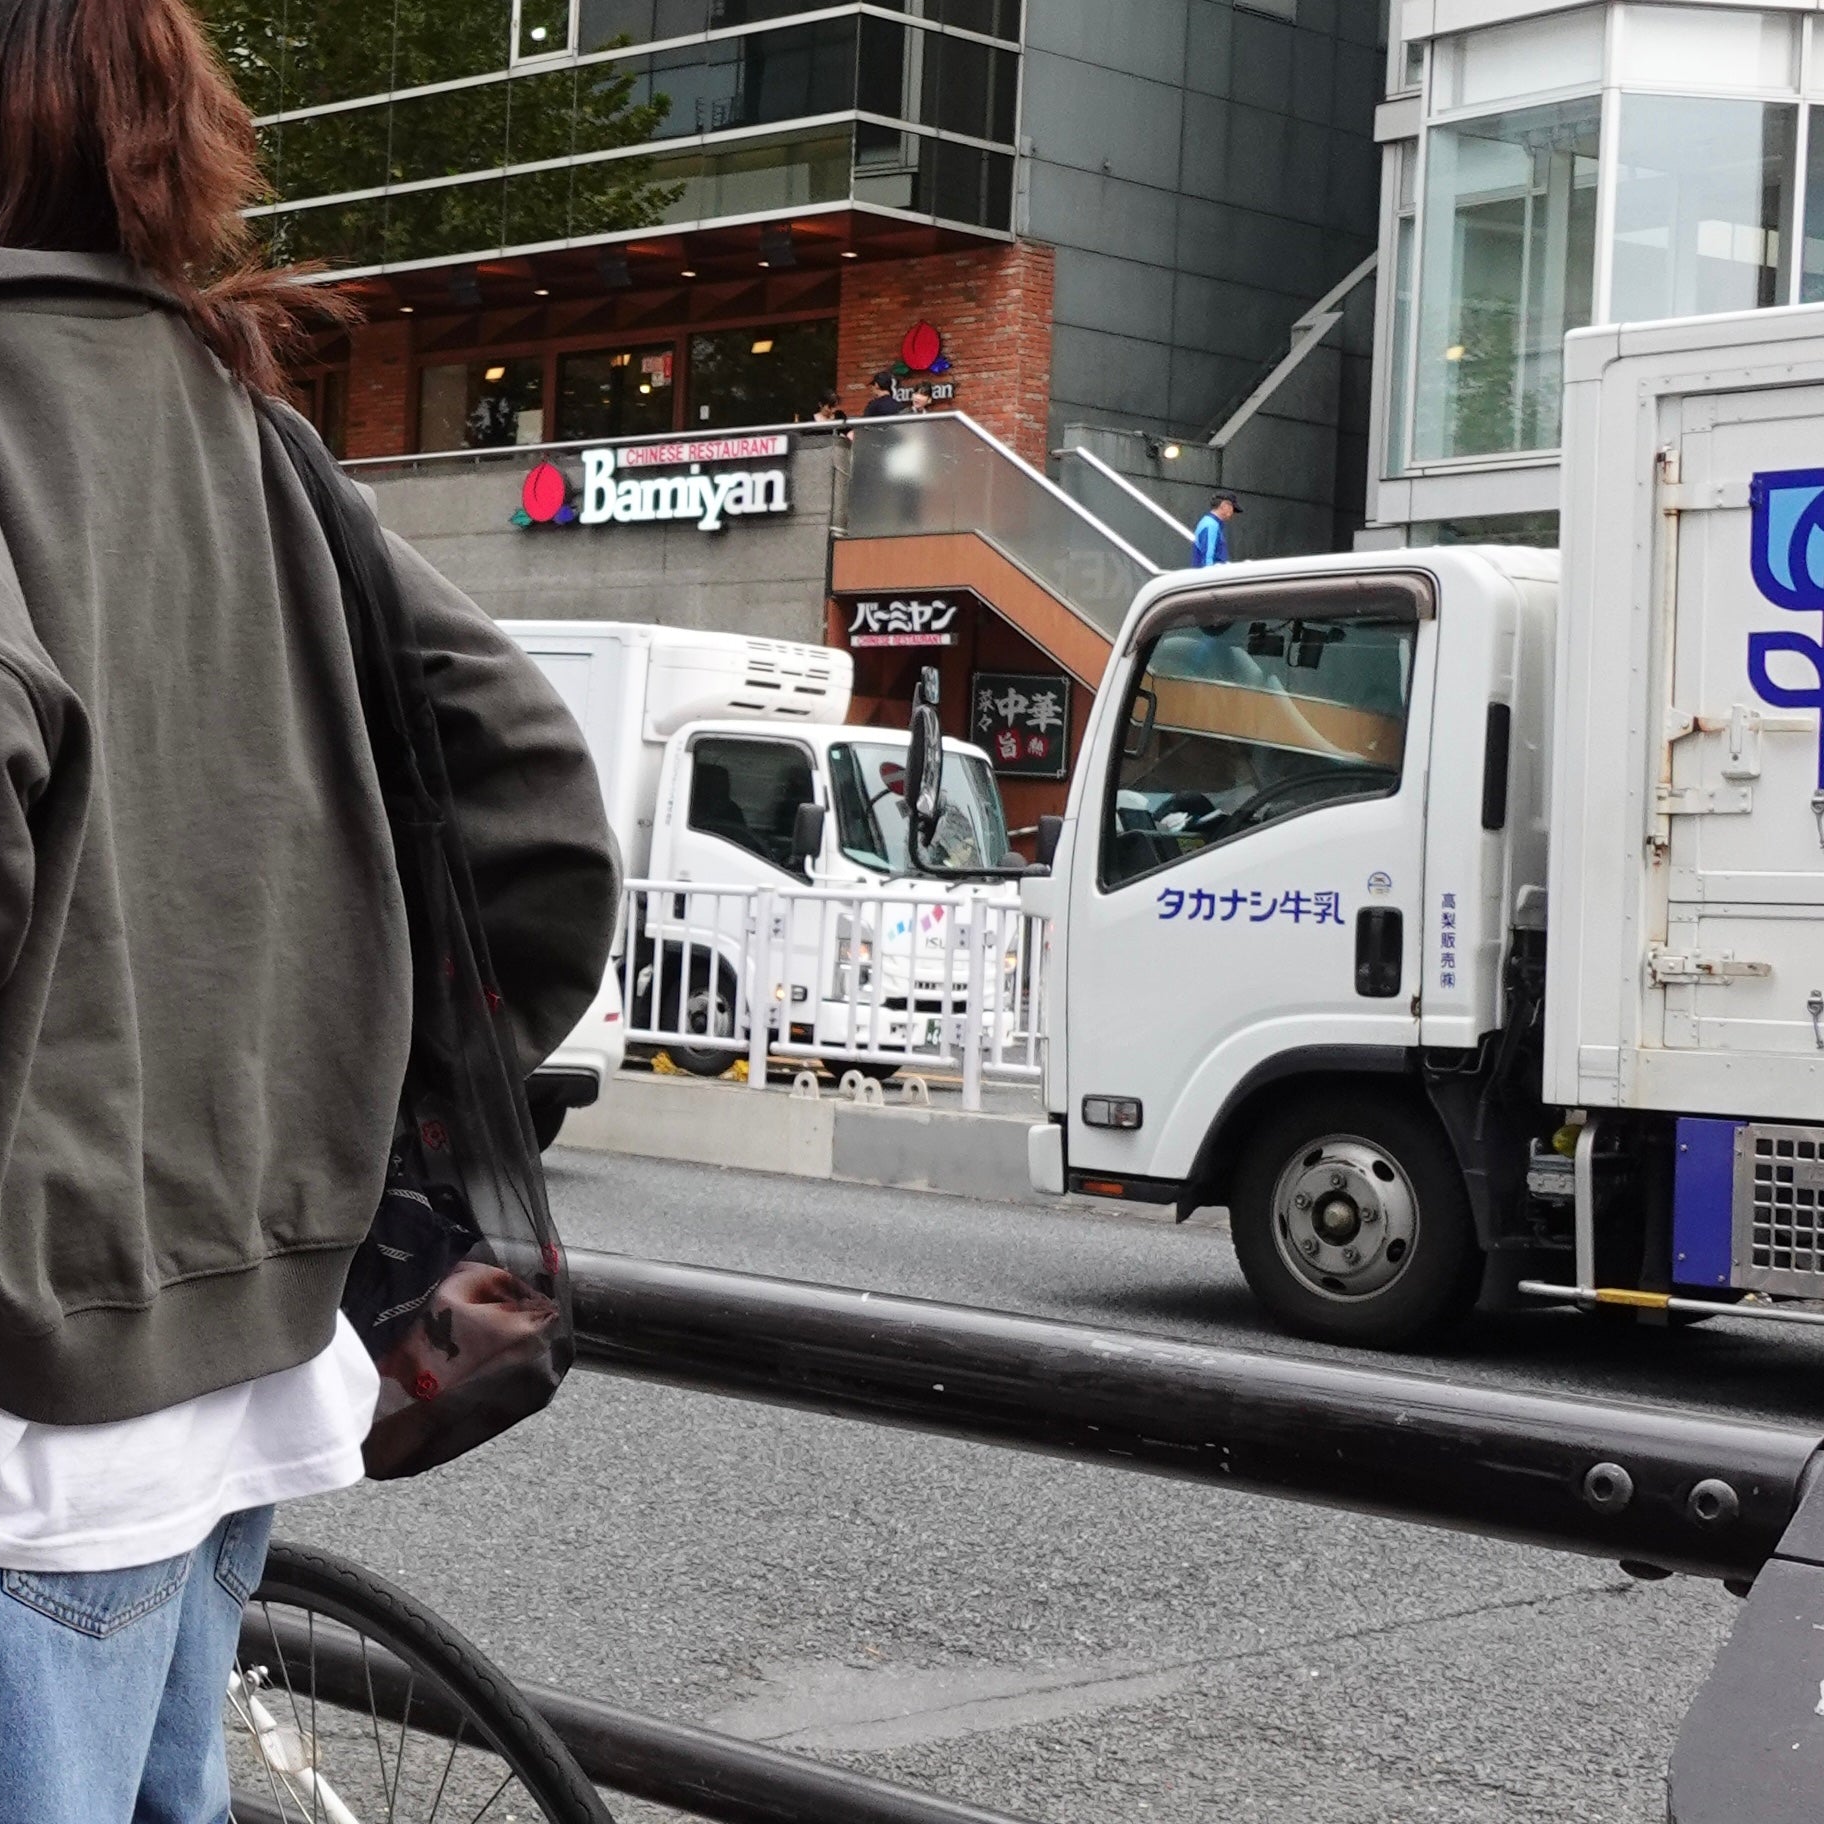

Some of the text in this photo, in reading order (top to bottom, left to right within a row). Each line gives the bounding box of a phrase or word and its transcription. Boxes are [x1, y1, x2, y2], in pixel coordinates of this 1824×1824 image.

[626, 437, 777, 465] CHINESE RESTAURANT
[579, 448, 788, 531] Bamiyan
[848, 600, 957, 633] バーミヤン
[995, 687, 1063, 734] 中華
[1157, 888, 1345, 925] タカナシ牛乳
